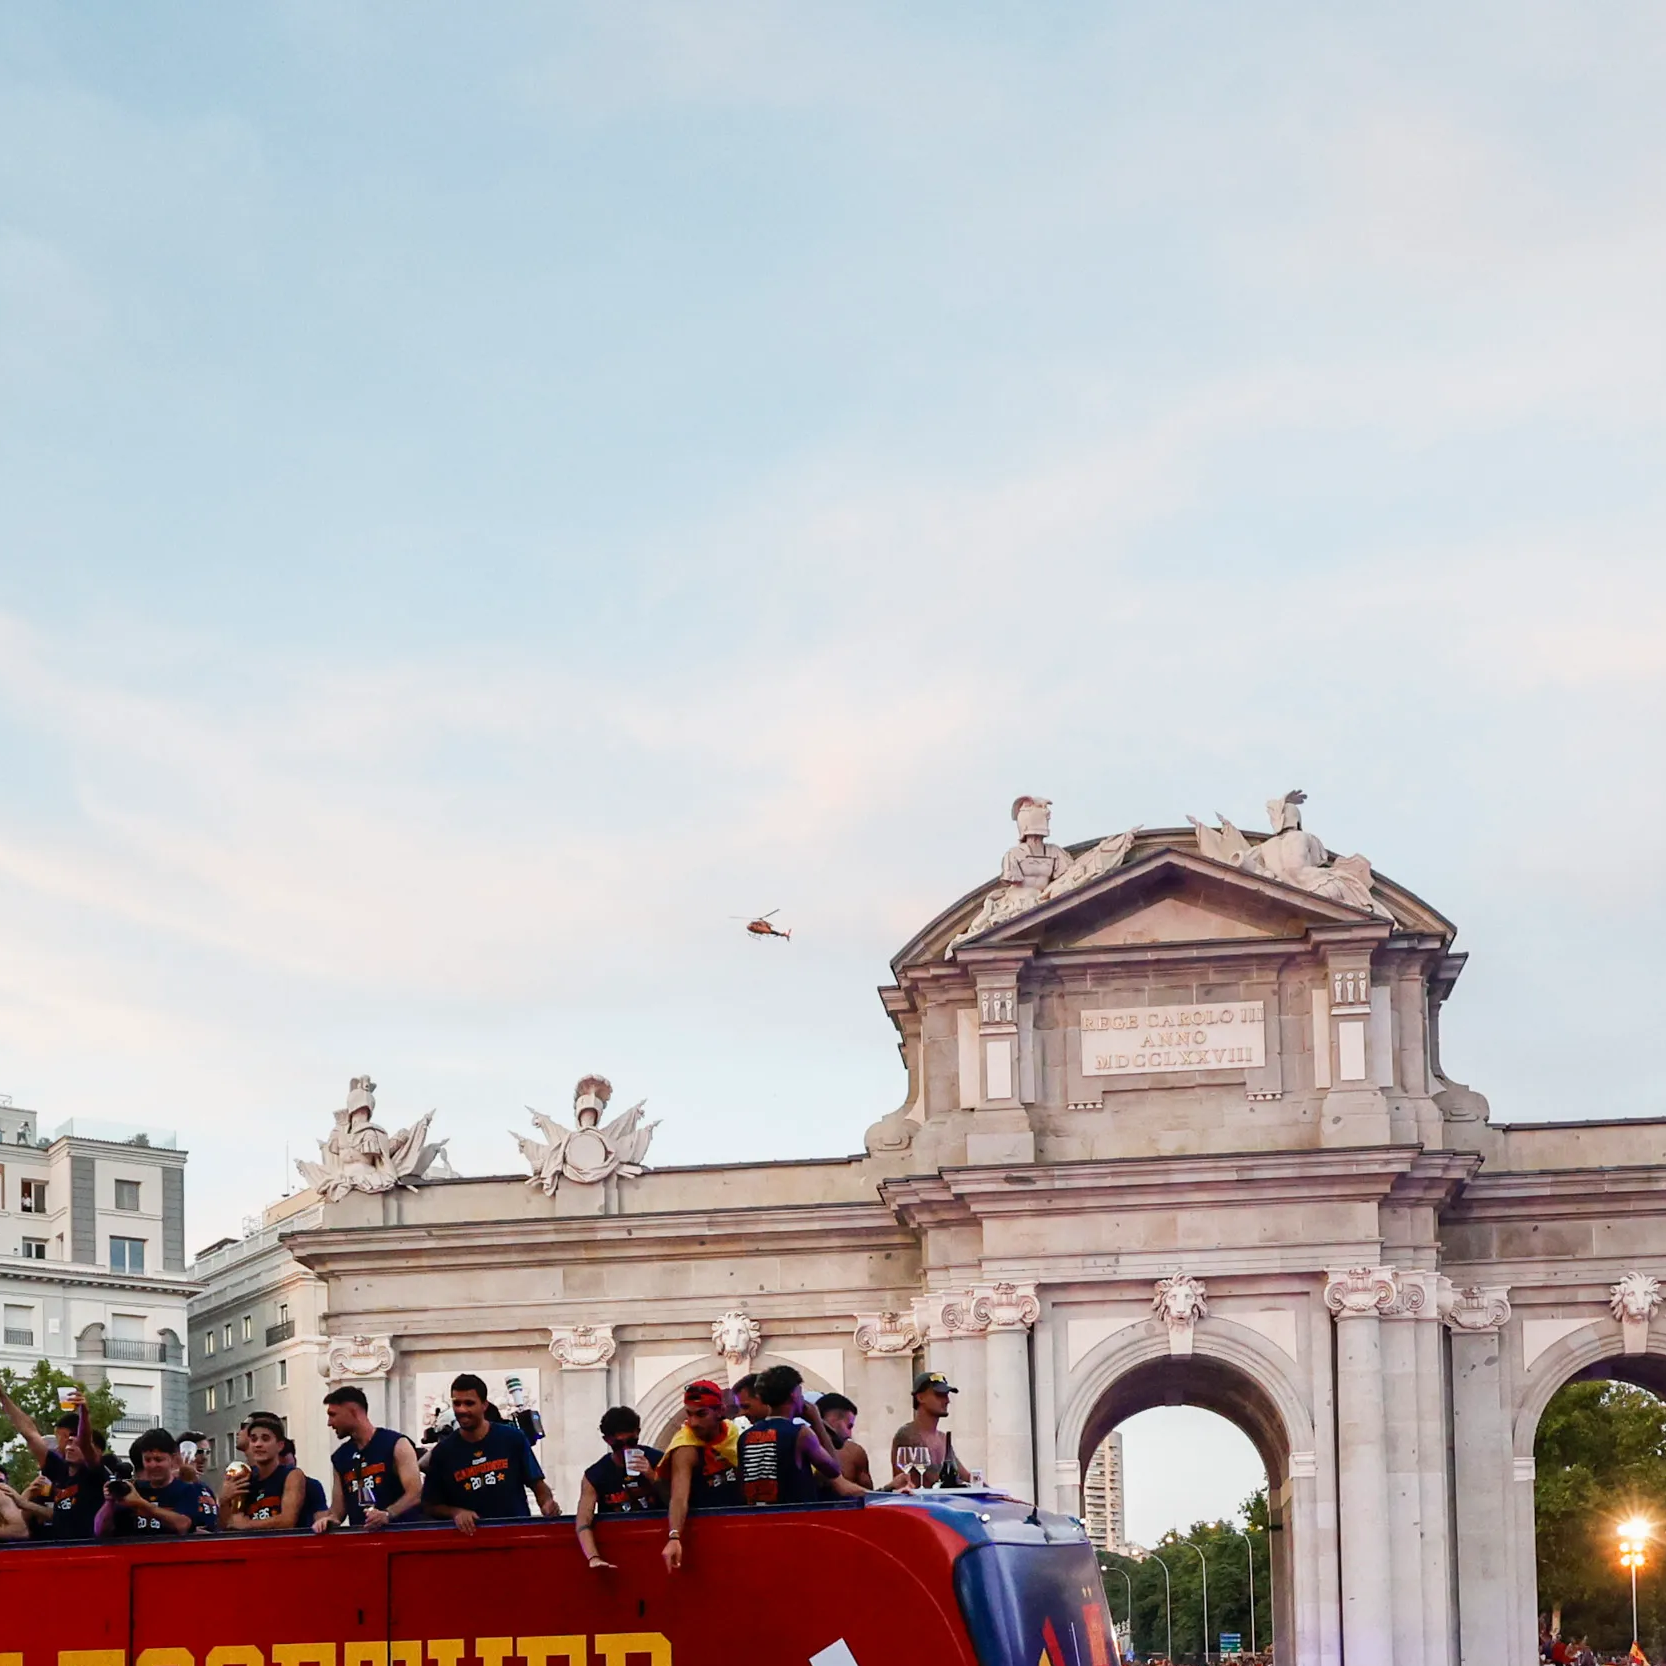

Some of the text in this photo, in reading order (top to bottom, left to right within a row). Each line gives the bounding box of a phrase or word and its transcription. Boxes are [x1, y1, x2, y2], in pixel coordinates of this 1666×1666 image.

[1083, 1007, 1264, 1031] REGE CAROLO III
[1141, 1030, 1207, 1048] ANNO
[1094, 1047, 1253, 1070] MDCCLXXVIII
